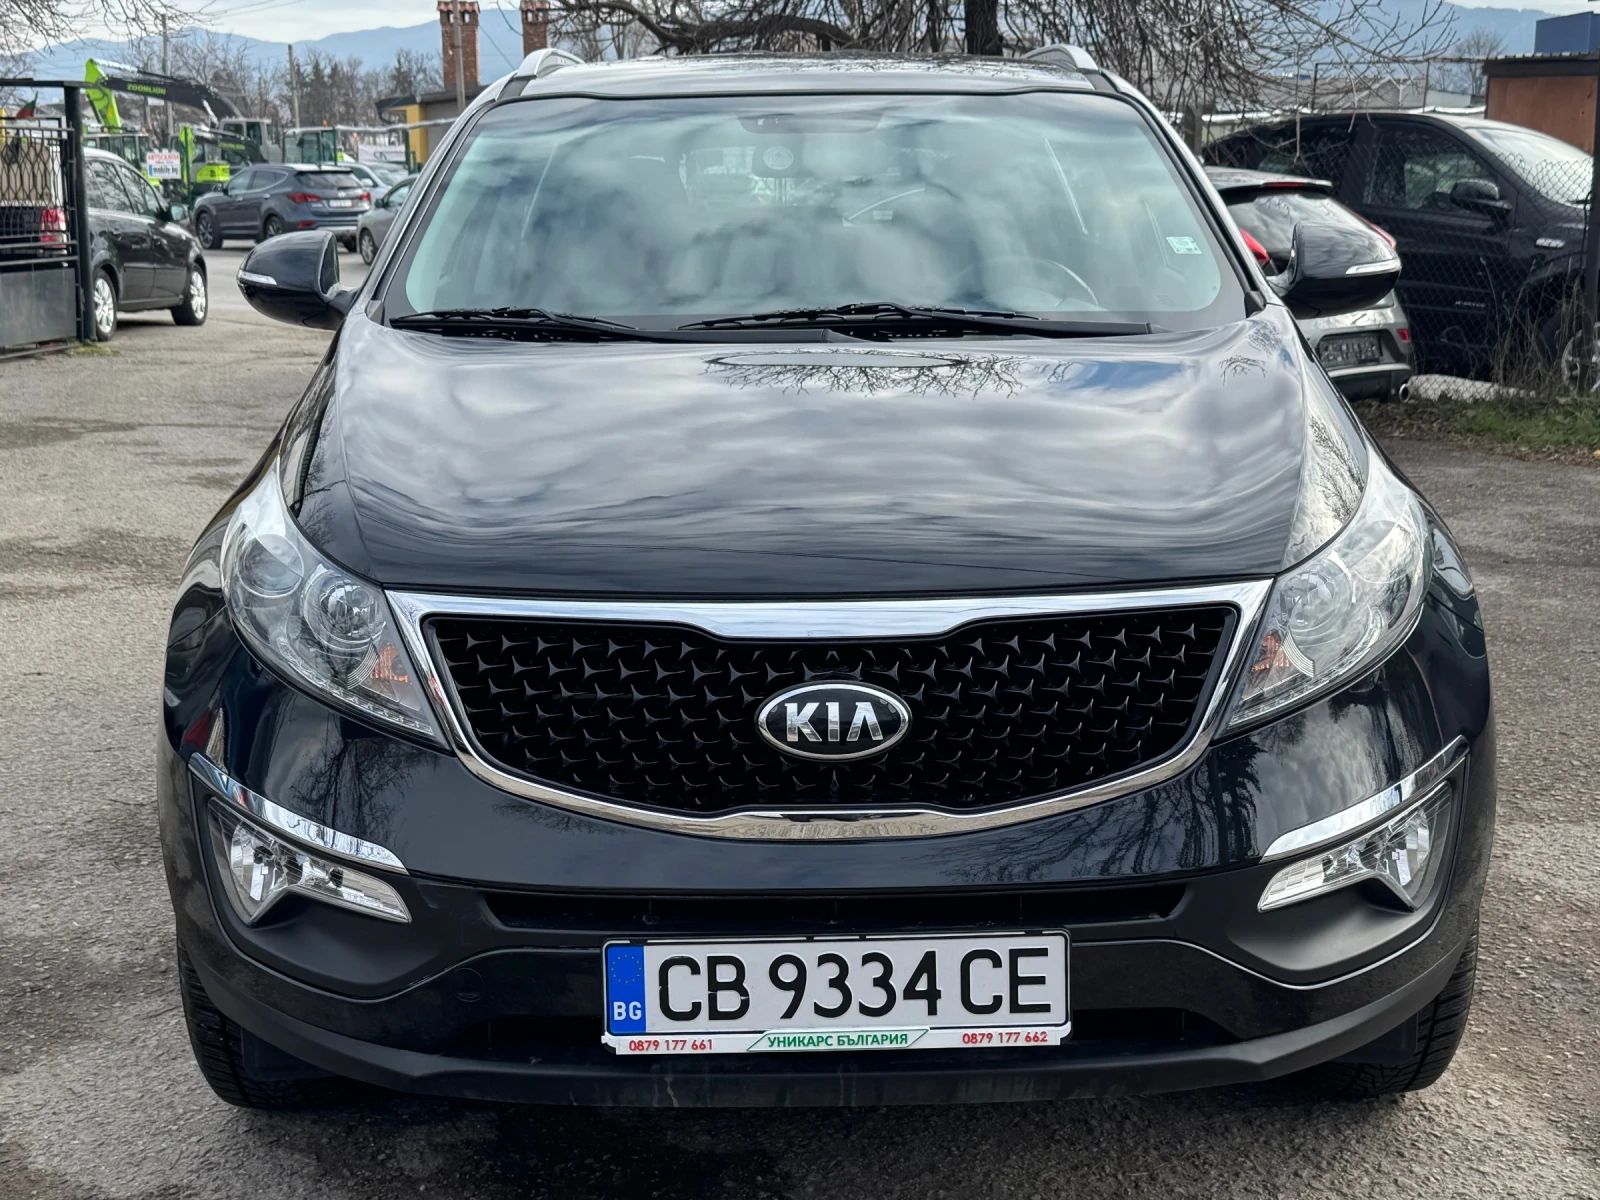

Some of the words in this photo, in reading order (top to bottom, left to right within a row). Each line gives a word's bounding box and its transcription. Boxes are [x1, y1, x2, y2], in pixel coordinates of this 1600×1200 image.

[127, 83, 166, 95] ZOOMLION
[785, 702, 883, 742] KIA
[658, 955, 750, 1021] CB
[768, 950, 942, 1019] 9334
[960, 947, 1051, 1015] CE
[613, 1001, 642, 1021] BG
[628, 1040, 660, 1052] 0879
[665, 1040, 687, 1051] 177
[690, 1039, 713, 1050] 661
[767, 1035, 833, 1049] УНИКАРС
[837, 1033, 908, 1046] БЪЛГАРИЯ
[962, 1032, 993, 1044] 0879
[998, 1031, 1021, 1043] 177
[1024, 1031, 1048, 1042] 662
